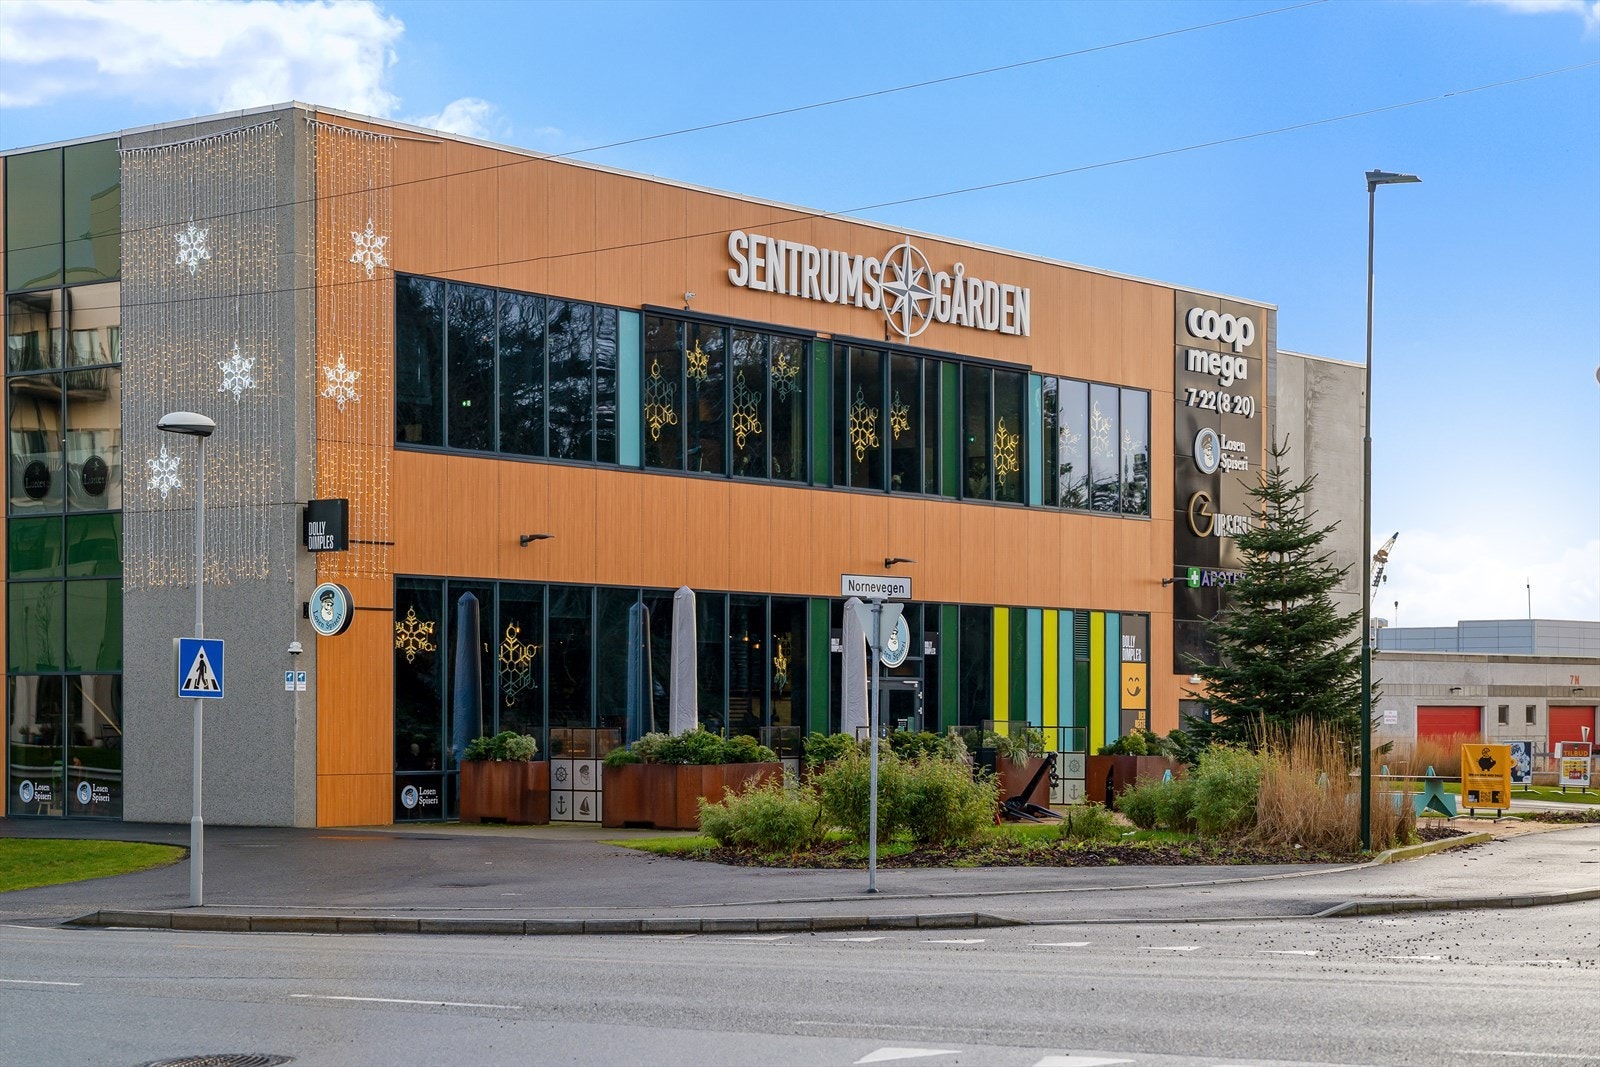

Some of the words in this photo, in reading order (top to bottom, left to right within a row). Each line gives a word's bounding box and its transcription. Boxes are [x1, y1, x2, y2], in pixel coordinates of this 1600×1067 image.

[728, 230, 881, 310] SENTRUMS
[934, 262, 1031, 337] GÅRDEN
[1187, 307, 1255, 353] coop
[1186, 349, 1248, 387] mega
[1220, 433, 1246, 452] Losen
[1220, 452, 1249, 473] Spiseri
[308, 521, 327, 536] DOLLY
[308, 535, 334, 550] DIMPLES
[848, 579, 905, 596] Nornevegen
[313, 609, 325, 629] Losen
[1122, 635, 1136, 648] DOLLY
[34, 782, 50, 791] Losen
[92, 783, 108, 792] Losen
[419, 786, 436, 795] Losen
[34, 791, 52, 801] Spiseri
[92, 792, 110, 803] Spiseri
[419, 795, 439, 807] Spiseri
